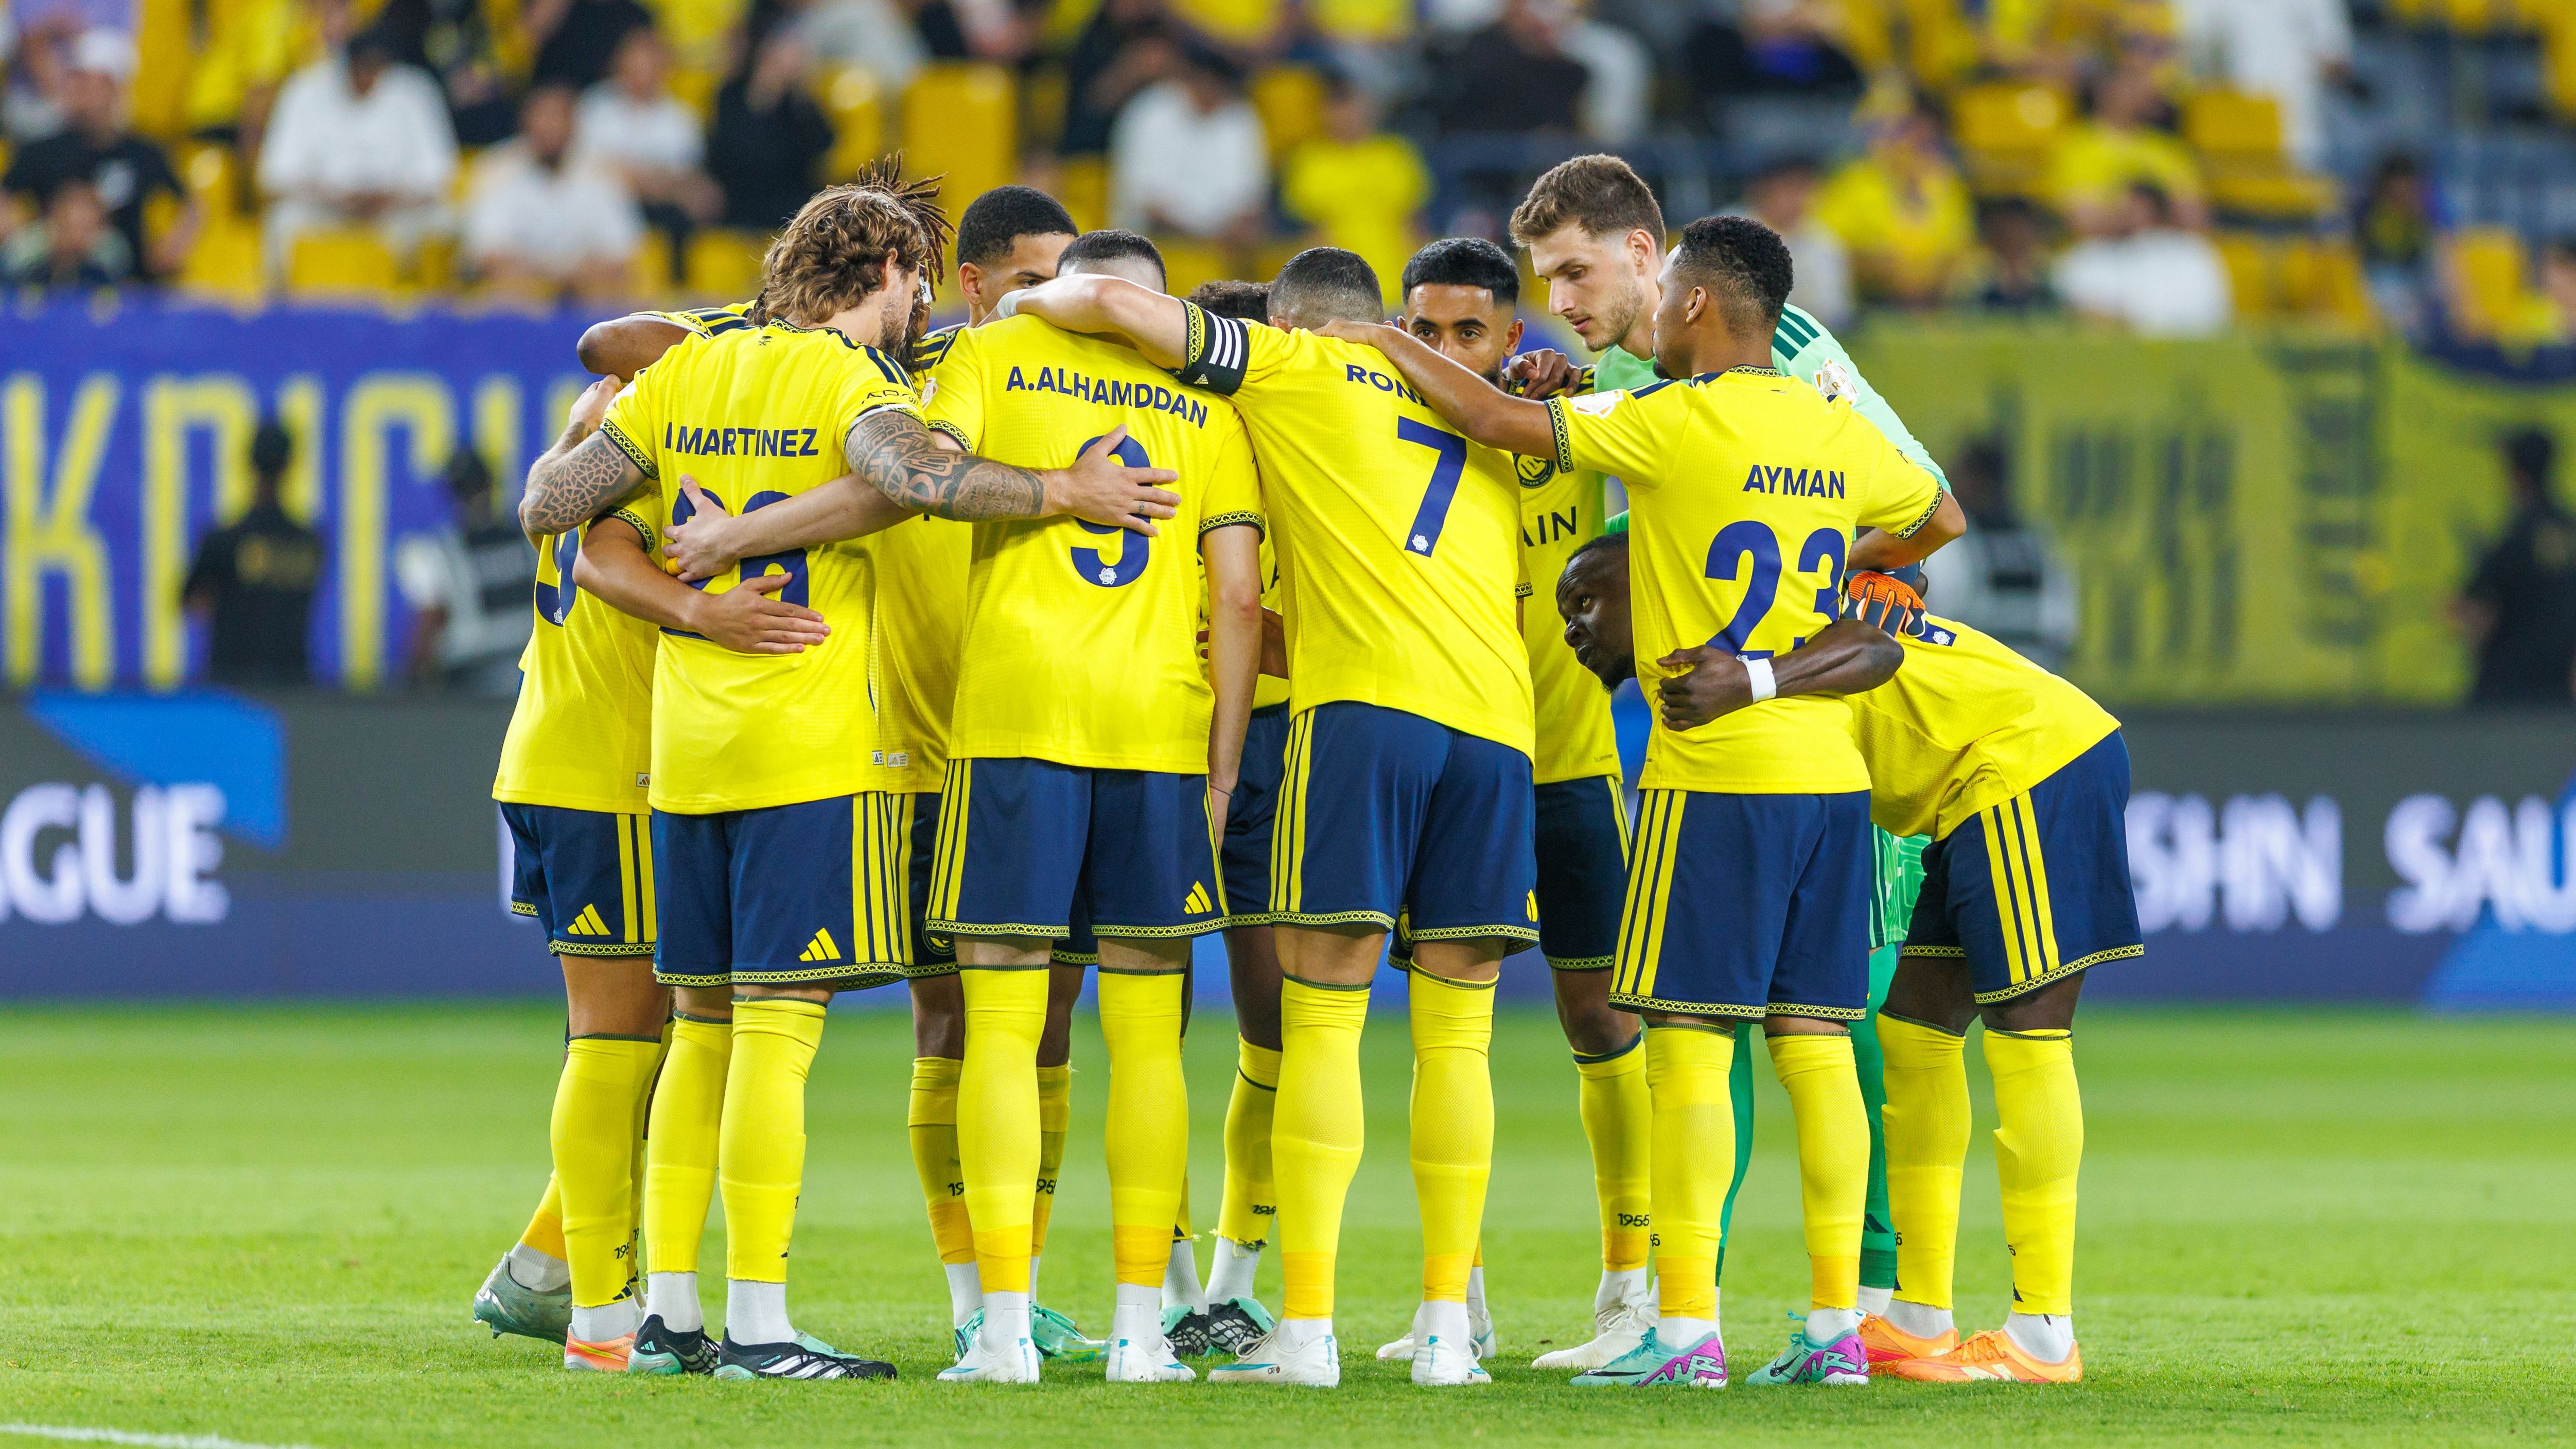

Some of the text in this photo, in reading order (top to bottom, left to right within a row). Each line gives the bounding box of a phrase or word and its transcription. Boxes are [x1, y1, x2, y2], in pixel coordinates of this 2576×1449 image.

[1006, 366, 1208, 429] A.ALHAMDDAN
[1346, 364, 1432, 409] RON
[676, 426, 819, 457] MARTINEZ
[1397, 415, 1467, 558] 7
[1743, 464, 1845, 499] AYMAN
[1704, 520, 1846, 661] 23
[0, 782, 231, 924] GUE
[1617, 1213, 1650, 1227] 1955
